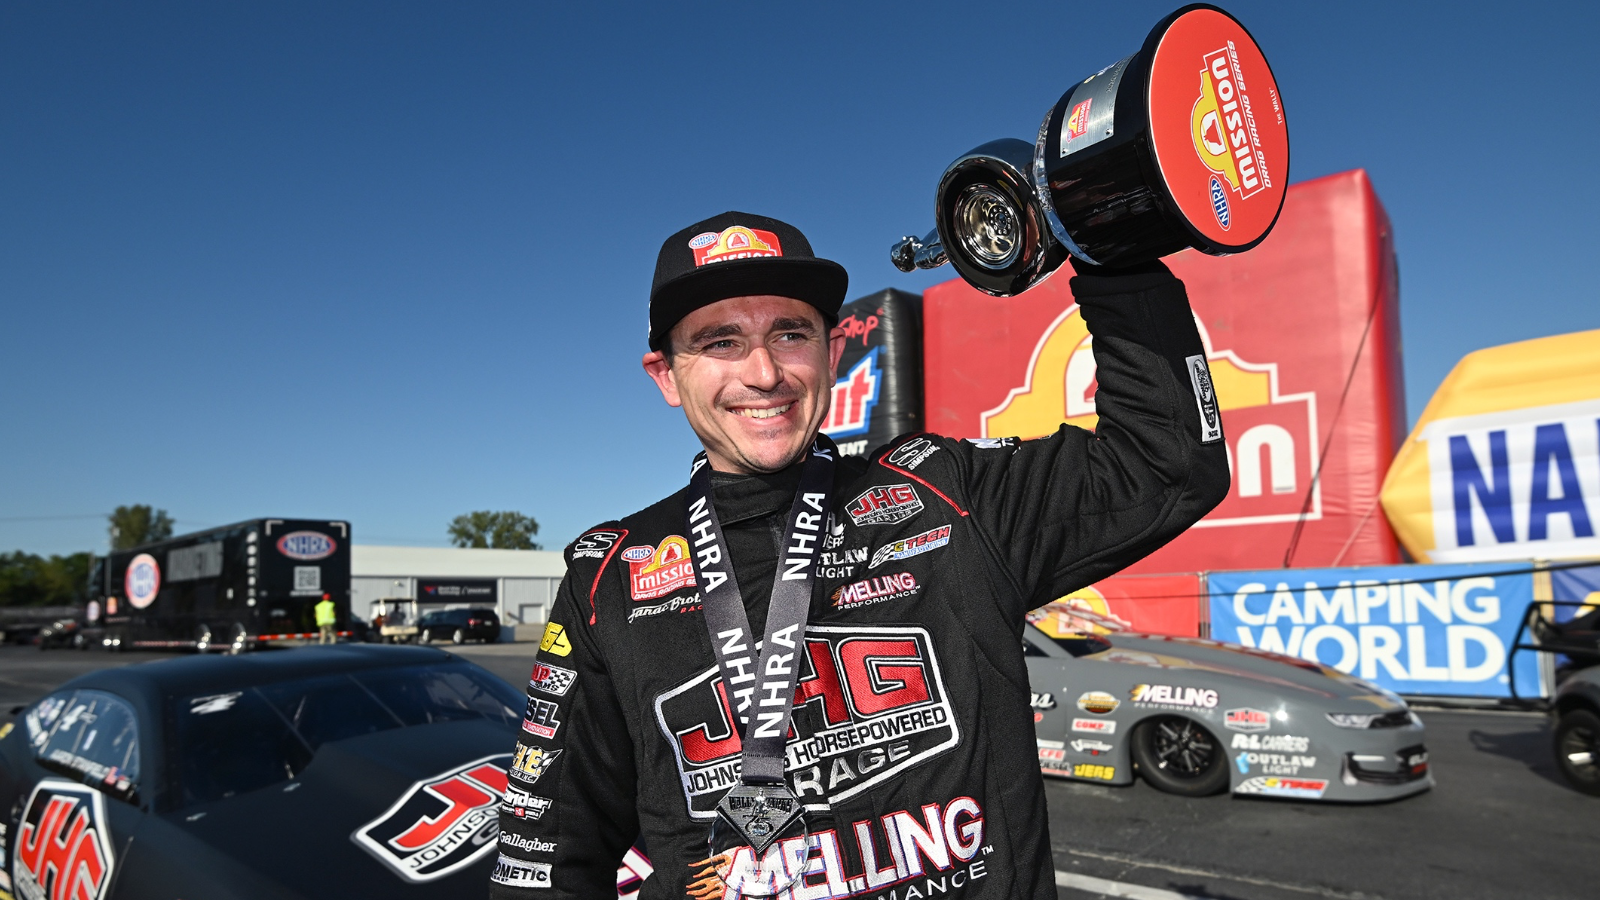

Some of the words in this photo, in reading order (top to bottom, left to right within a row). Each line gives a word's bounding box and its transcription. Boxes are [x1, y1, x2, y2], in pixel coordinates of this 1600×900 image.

[1227, 40, 1246, 92] SERIES
[1269, 87, 1280, 113] WALLY
[1242, 94, 1261, 148] RACING
[1256, 149, 1272, 188] DRAG
[1212, 182, 1229, 222] NHRA
[907, 443, 939, 471] SIMPSON
[1449, 417, 1600, 548] NA
[851, 485, 916, 517] JHG
[287, 536, 328, 555] NHRA
[688, 495, 728, 594] NHRA
[782, 491, 827, 582] NHRA
[905, 526, 950, 550] TECH
[626, 548, 651, 560] NHRA
[818, 546, 869, 566] TLAW
[815, 566, 854, 579] LIGHT
[634, 591, 657, 600] DRAG
[837, 572, 917, 607] MELLING
[838, 589, 918, 611] PERFORMANCE
[1233, 577, 1500, 626] CAMPING
[1235, 624, 1507, 684] WORLD
[753, 622, 800, 740] NHRA
[1134, 702, 1215, 715] PERFORMANCE
[1136, 683, 1220, 709] MELLING
[1227, 711, 1267, 724] JHG
[797, 706, 948, 768] HORSEPOWERED
[1246, 752, 1317, 768] OUTLAW
[1262, 764, 1300, 776] LIGHT
[500, 831, 557, 852] Gallagher
[721, 796, 986, 900] MELLING
